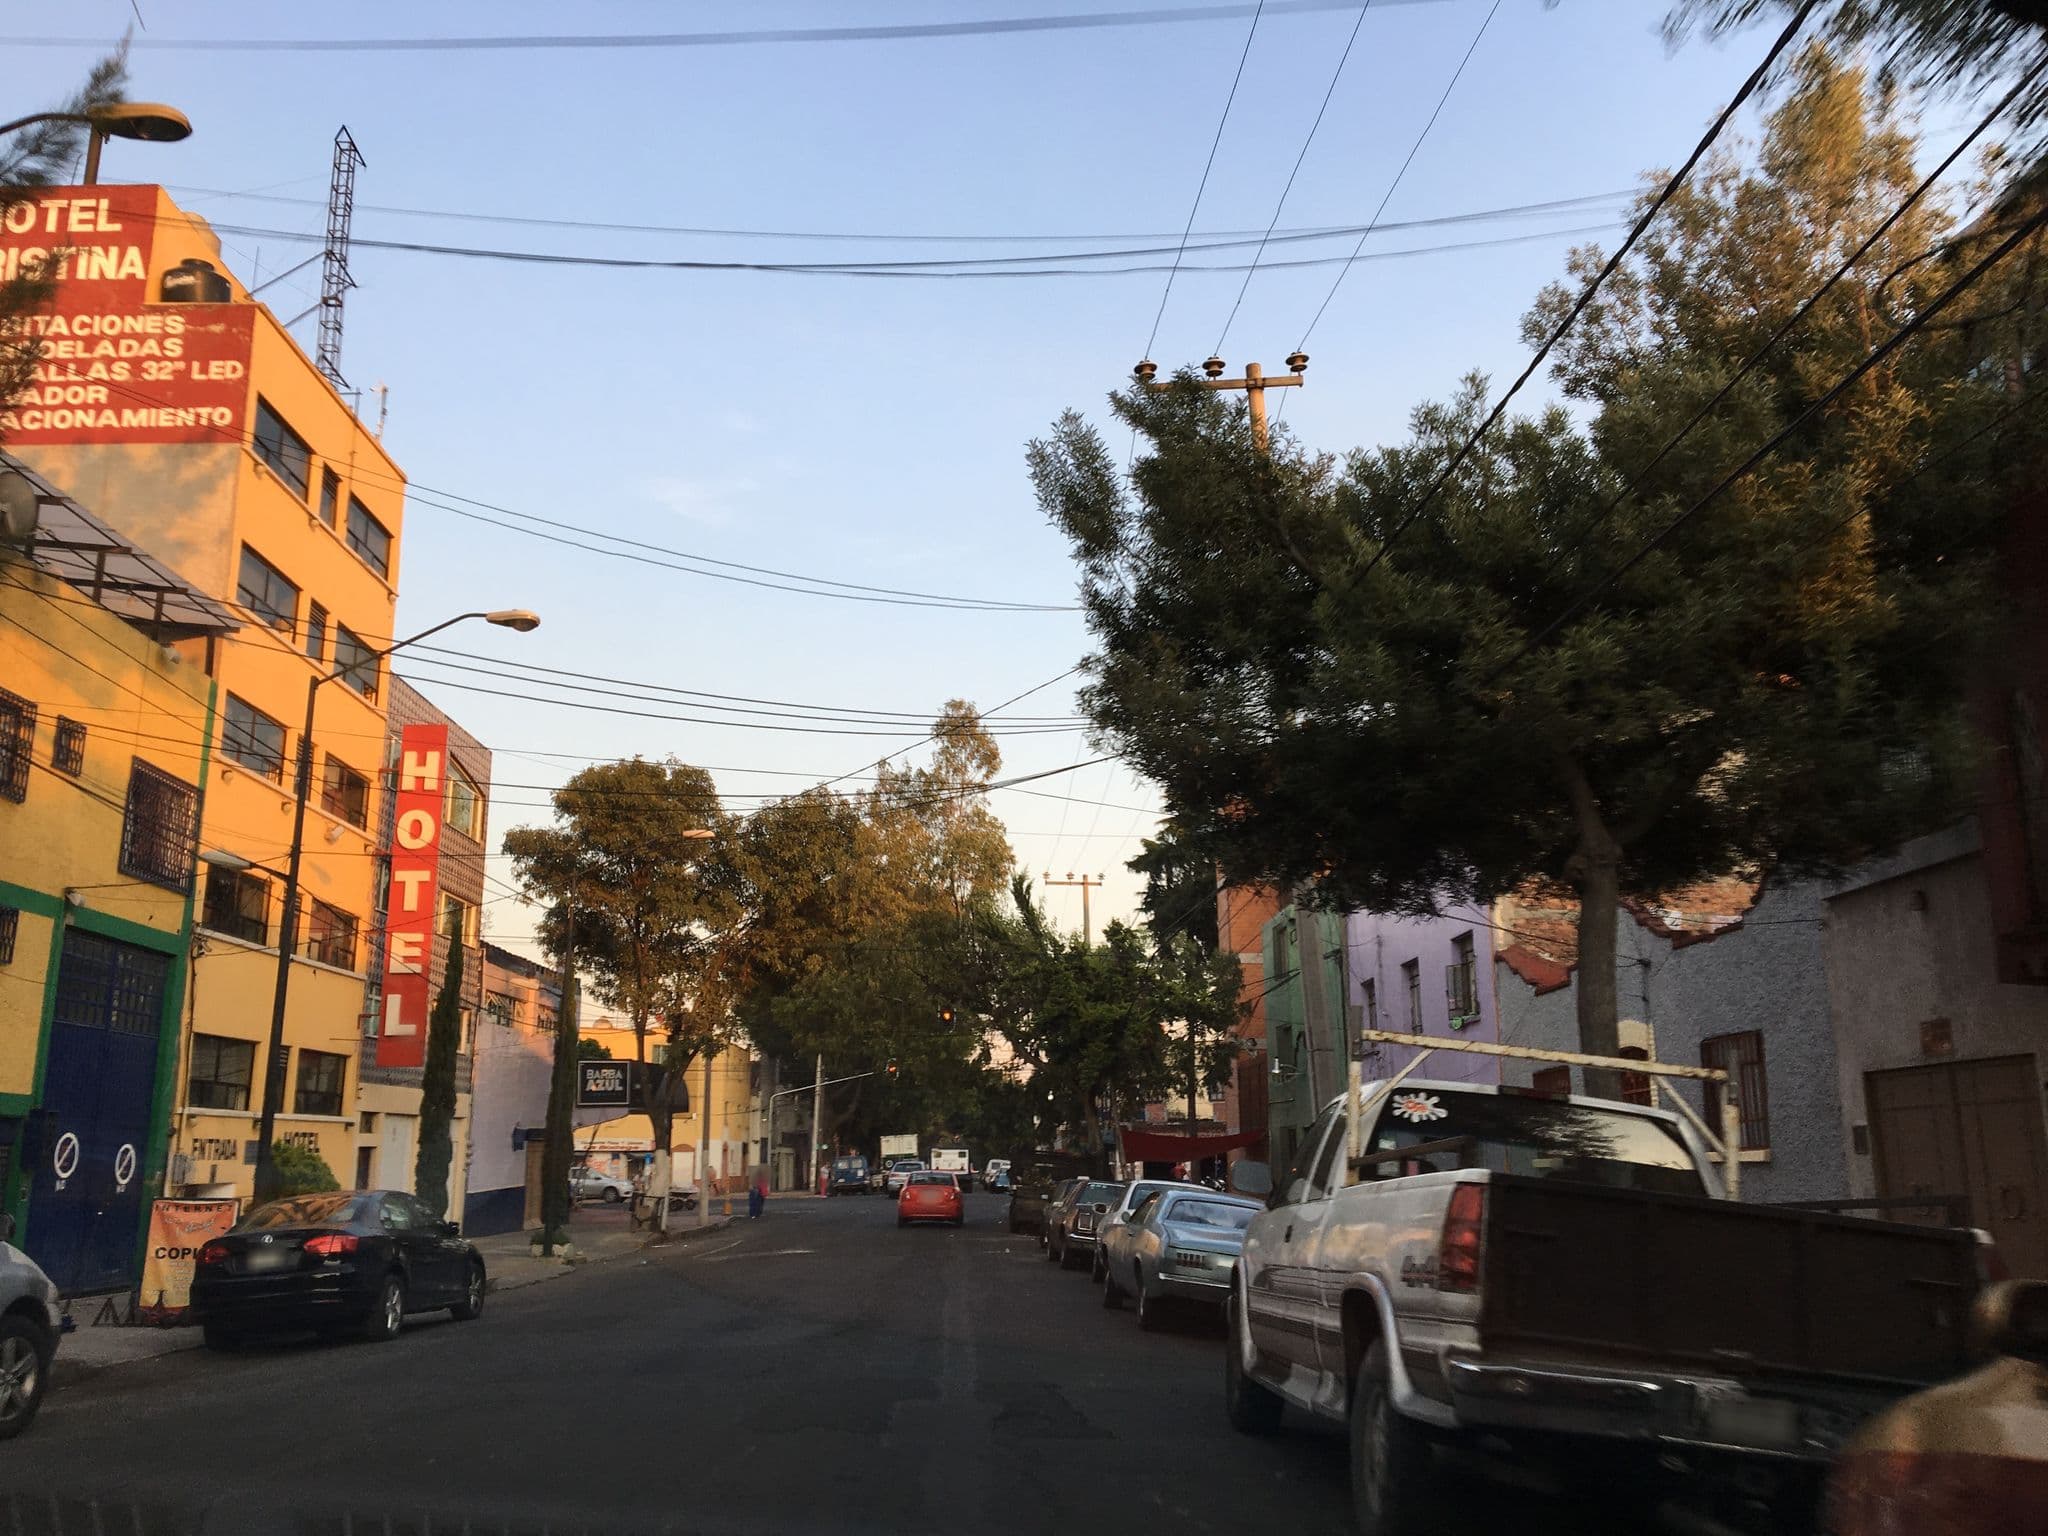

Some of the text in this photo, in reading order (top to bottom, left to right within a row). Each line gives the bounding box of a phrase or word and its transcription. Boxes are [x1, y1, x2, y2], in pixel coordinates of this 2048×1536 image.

[0, 199, 123, 234] OTEL
[191, 360, 244, 380] LED
[0, 407, 233, 430] ACIONAMIENTO
[384, 751, 441, 1036] HOTEL
[586, 1069, 622, 1079] BARBA
[585, 1080, 623, 1092] AZUL
[192, 1138, 238, 1161] ENTRADA
[284, 1132, 319, 1153] HOTEL
[154, 1204, 233, 1213] INTERNET
